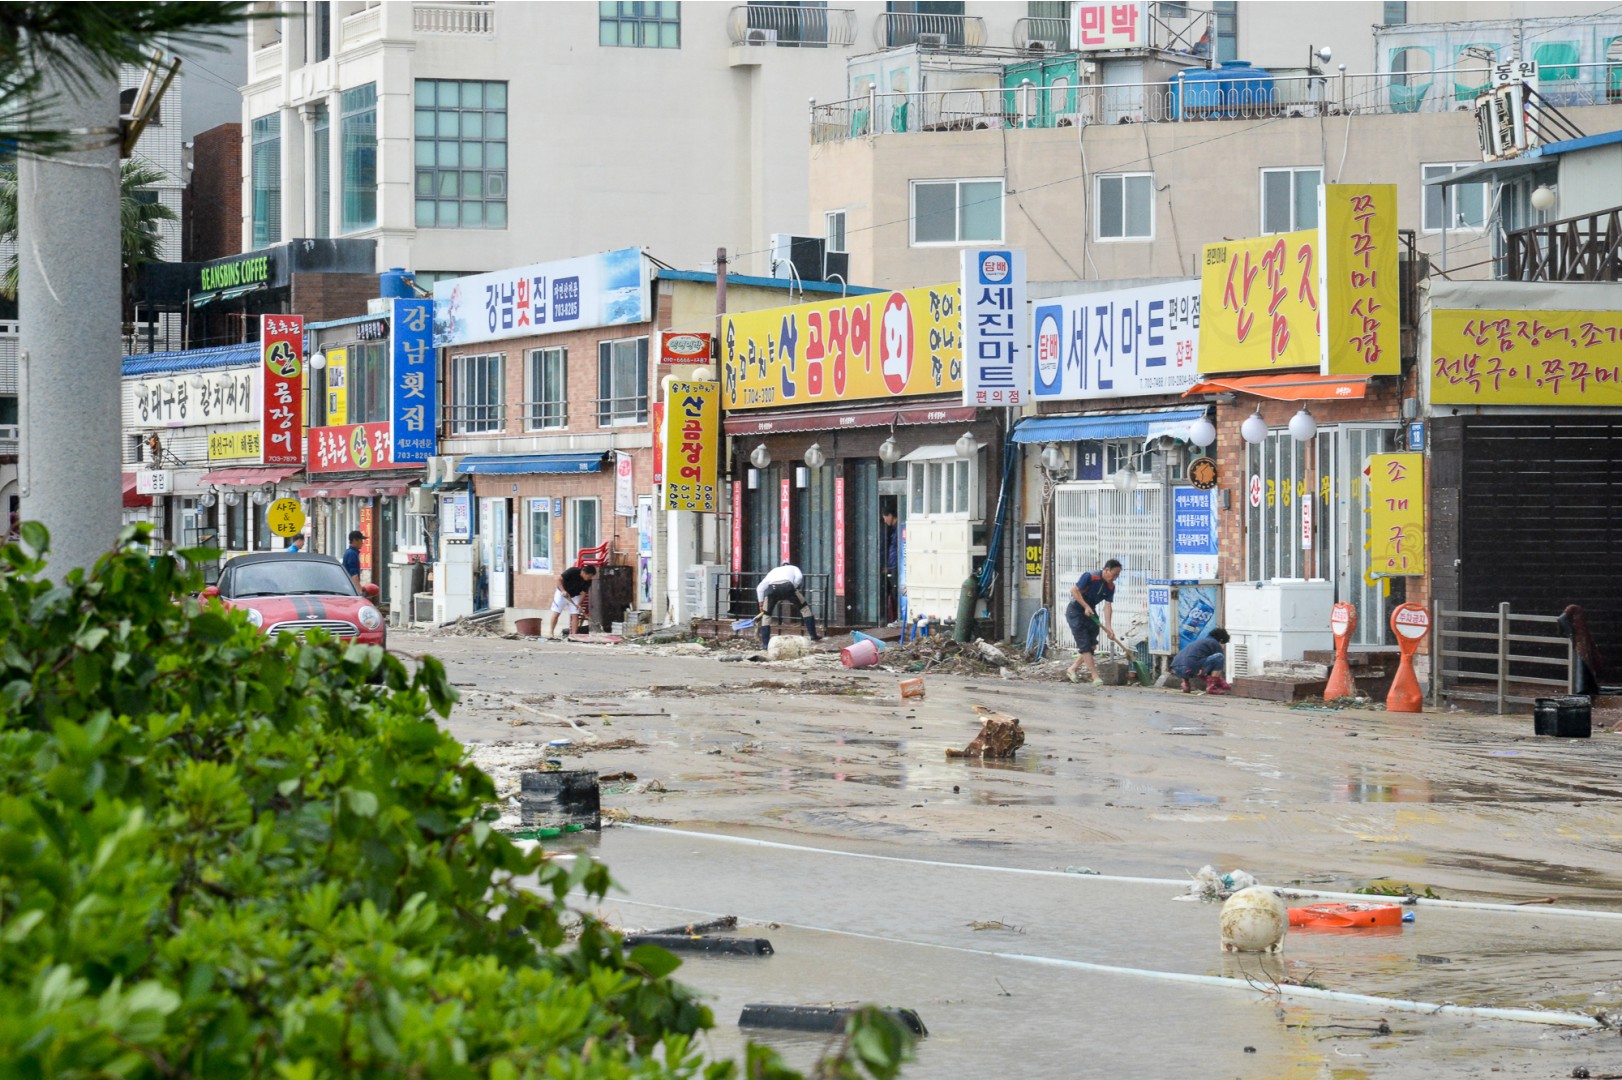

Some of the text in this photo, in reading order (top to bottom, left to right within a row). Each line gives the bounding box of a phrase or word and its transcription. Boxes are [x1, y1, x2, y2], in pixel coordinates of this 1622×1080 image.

[1080, 4, 1138, 45] 민박
[201, 256, 268, 291] BEANSBINS COFFEE
[984, 260, 1008, 272] 담배
[485, 275, 546, 334] 강남횟집
[554, 302, 578, 318] 703-8285
[1168, 295, 1201, 331] 편의점
[266, 318, 301, 335] 춤추는
[977, 286, 1019, 389] 세진마트
[725, 318, 738, 406] 송정
[739, 332, 776, 383] 꼬리치는
[883, 301, 908, 386] 회
[1039, 333, 1058, 361] 담배
[1067, 299, 1167, 391] 세진마트
[1176, 339, 1194, 368] 잡화
[400, 305, 431, 432] 강남횟집
[138, 375, 251, 422] 생대구탕 칼치찌개
[975, 390, 1020, 405] 편의점
[317, 430, 347, 467] 춤추는
[1413, 431, 1421, 443] 18
[276, 501, 297, 512] 사주
[283, 512, 290, 521] &
[1385, 460, 1409, 569] 조개구이
[277, 523, 296, 533] 타로
[1399, 613, 1426, 624] 주차금지
